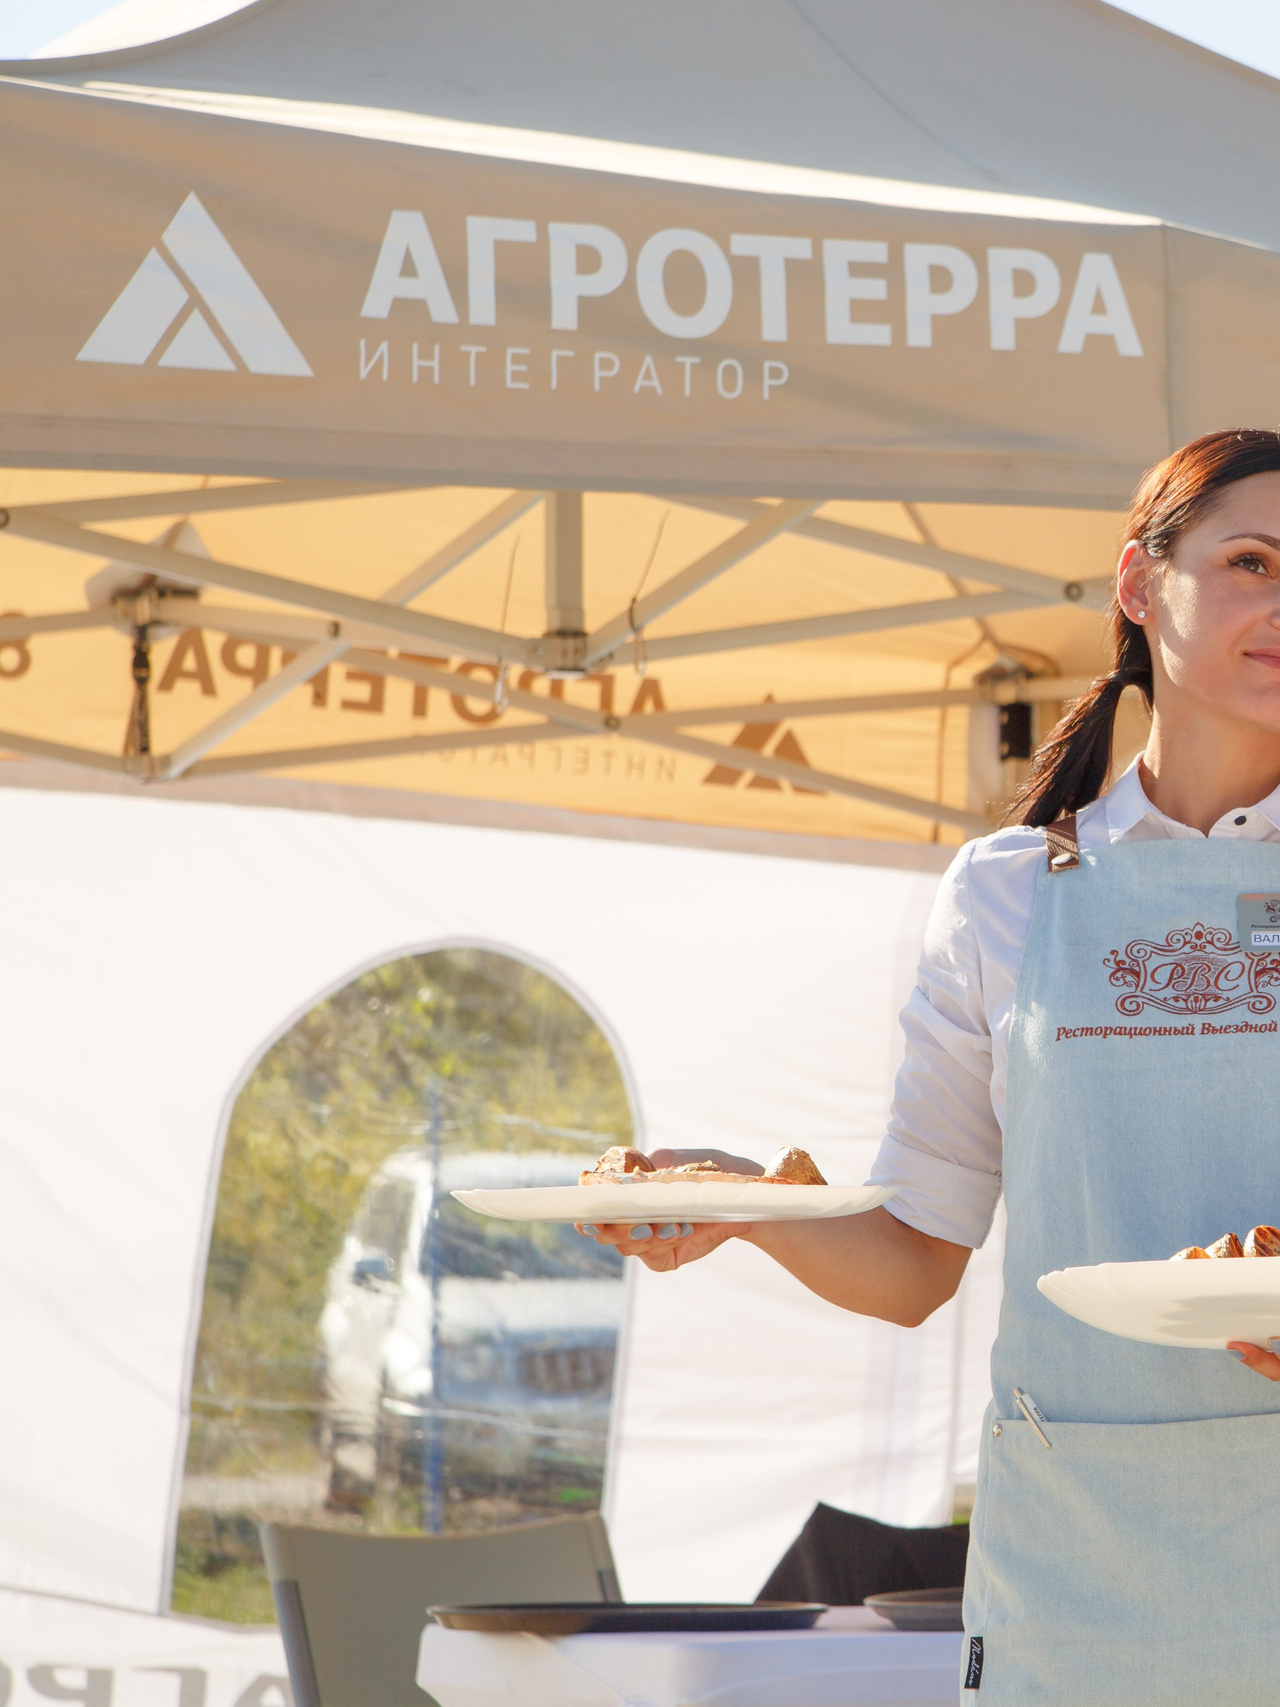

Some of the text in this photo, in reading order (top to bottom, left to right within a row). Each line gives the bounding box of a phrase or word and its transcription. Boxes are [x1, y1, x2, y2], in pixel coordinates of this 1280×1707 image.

[359, 209, 1144, 358] АГРОТЕРРА
[358, 338, 790, 401] ИНТЕГРАТОР
[1055, 1022, 1196, 1042] Ресторационный
[1201, 1020, 1278, 1037] Выездной
